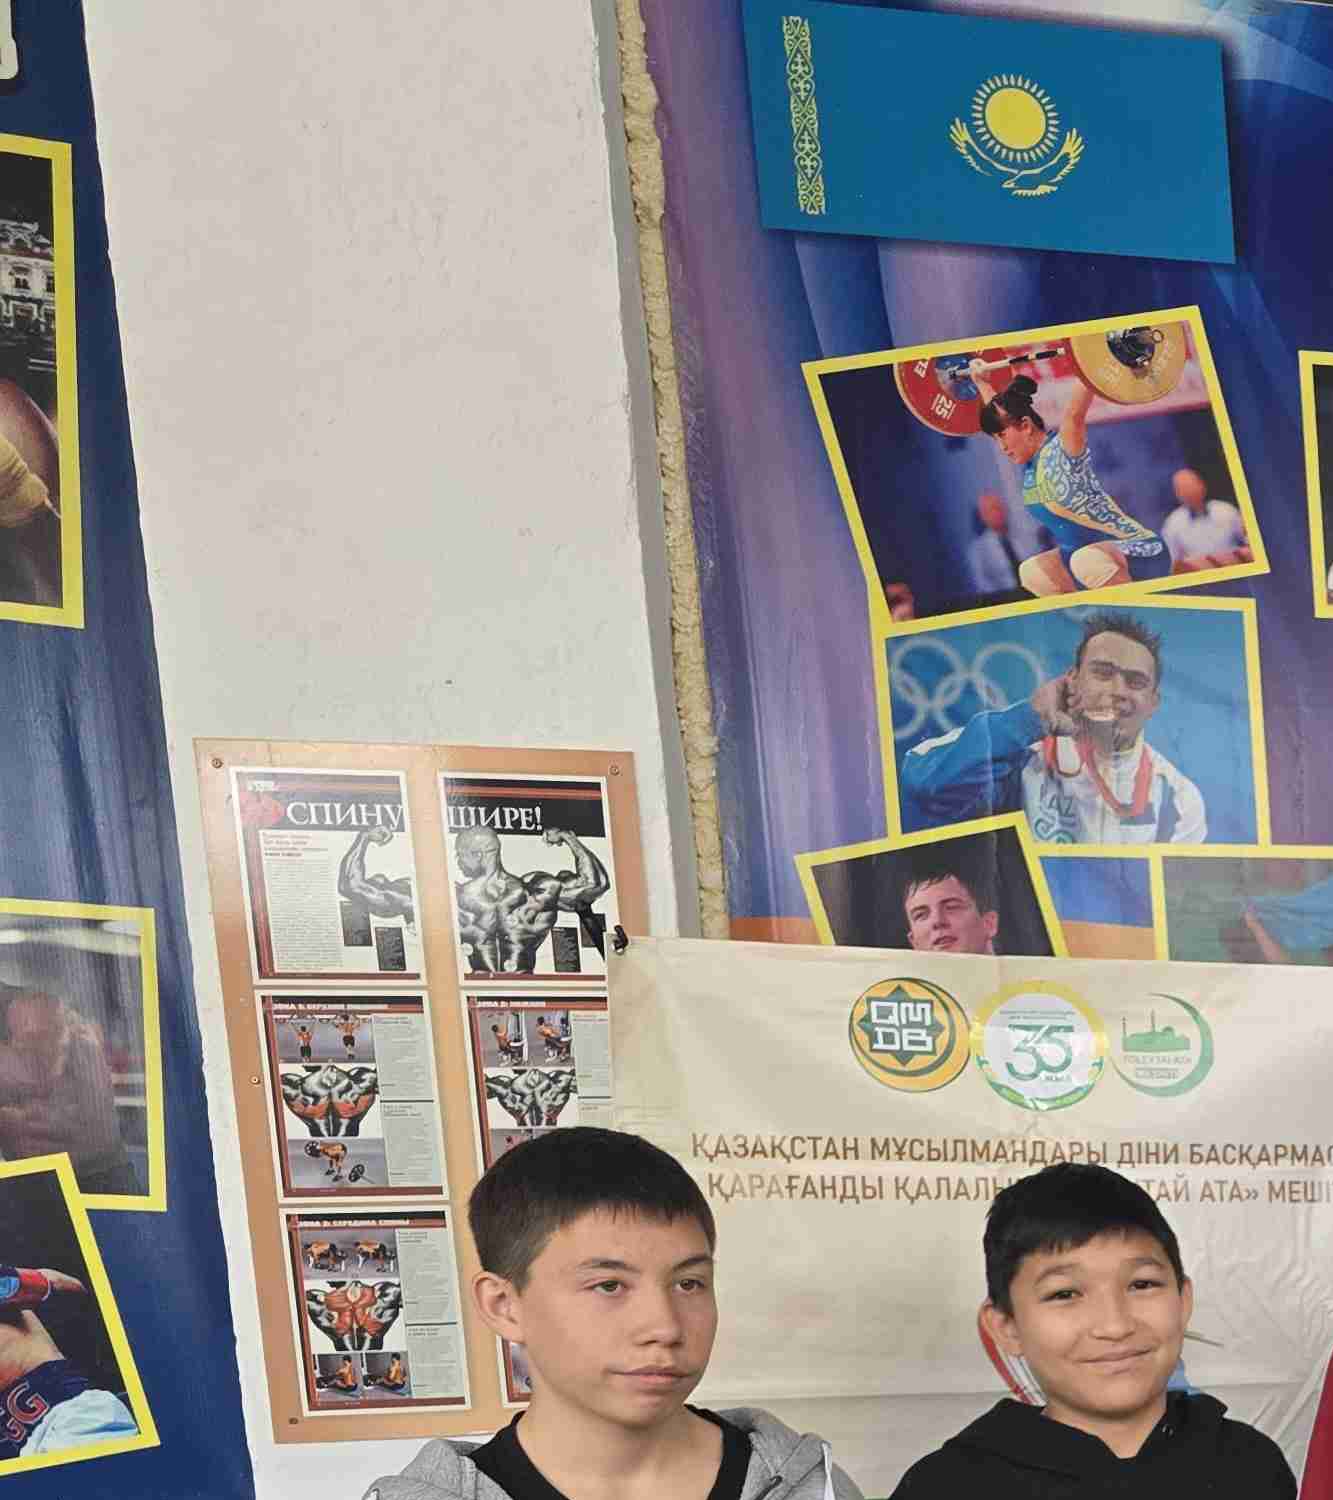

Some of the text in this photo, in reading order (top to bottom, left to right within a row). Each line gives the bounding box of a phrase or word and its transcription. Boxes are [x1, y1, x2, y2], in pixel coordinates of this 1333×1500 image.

[286, 801, 543, 831] СПИНУ ШИРЕ!
[691, 1134, 858, 1165] ҚАЗАҚСТАН
[870, 1137, 1107, 1167] МҰСЫЛМАНДАРЫ
[1118, 1142, 1180, 1168] ДІНИ
[707, 1172, 884, 1204] ҚАРАҒАНДЫ
